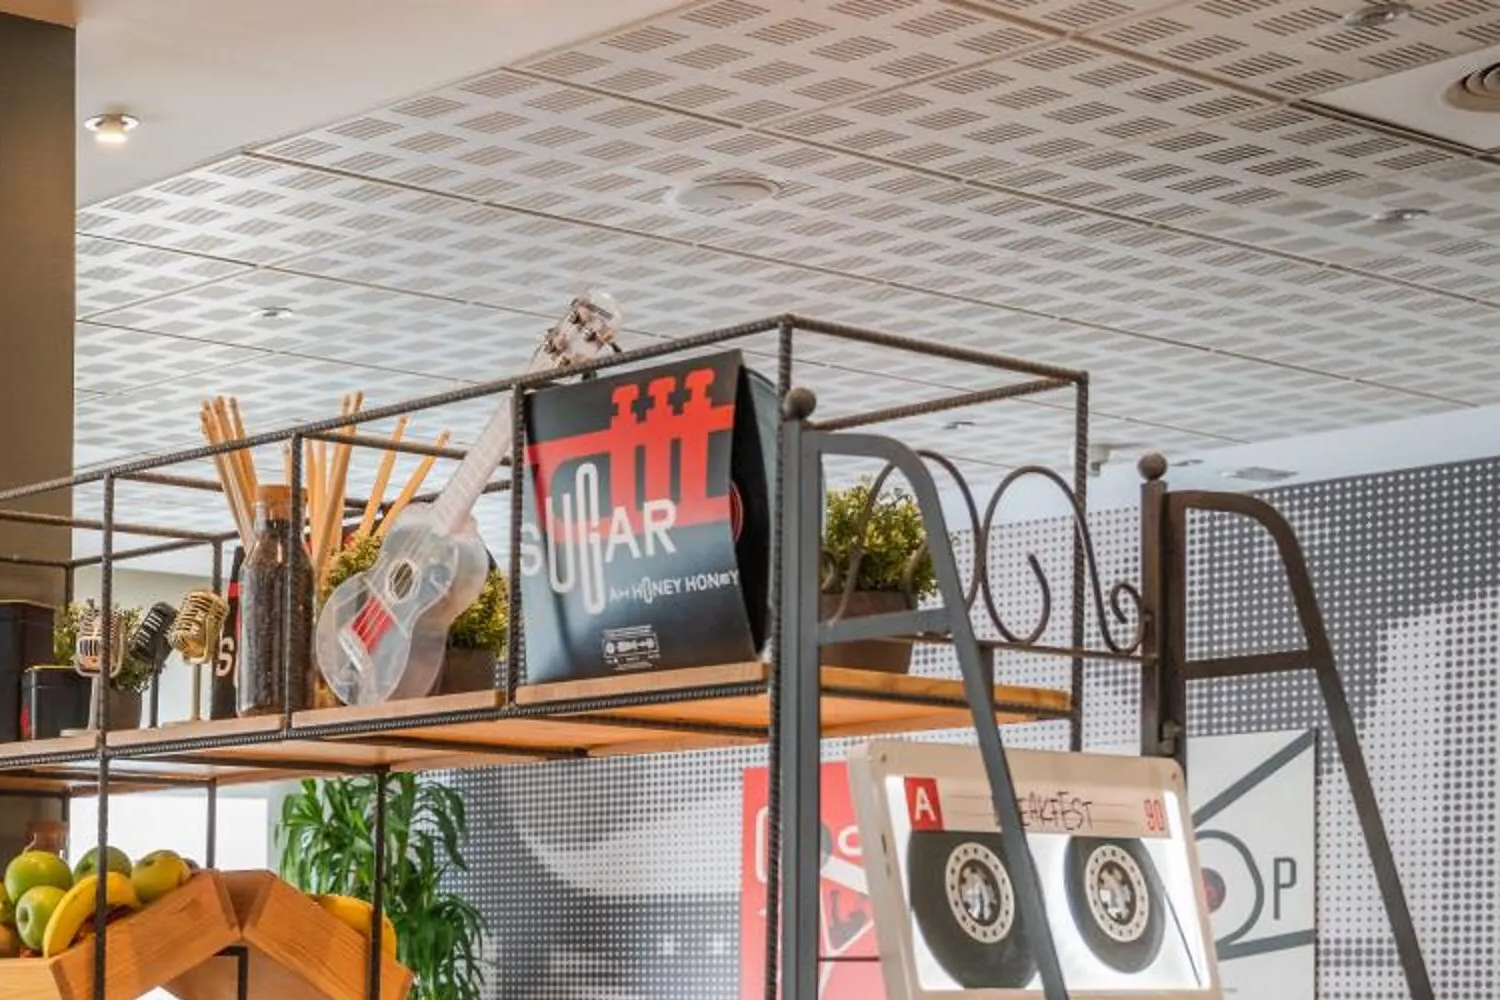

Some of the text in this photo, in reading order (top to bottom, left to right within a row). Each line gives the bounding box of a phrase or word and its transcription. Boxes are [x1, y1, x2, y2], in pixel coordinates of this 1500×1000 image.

[520, 462, 678, 615] SUGAR
[631, 576, 682, 604] HONEY
[914, 786, 936, 822] A
[996, 790, 1094, 832] EAKFEST
